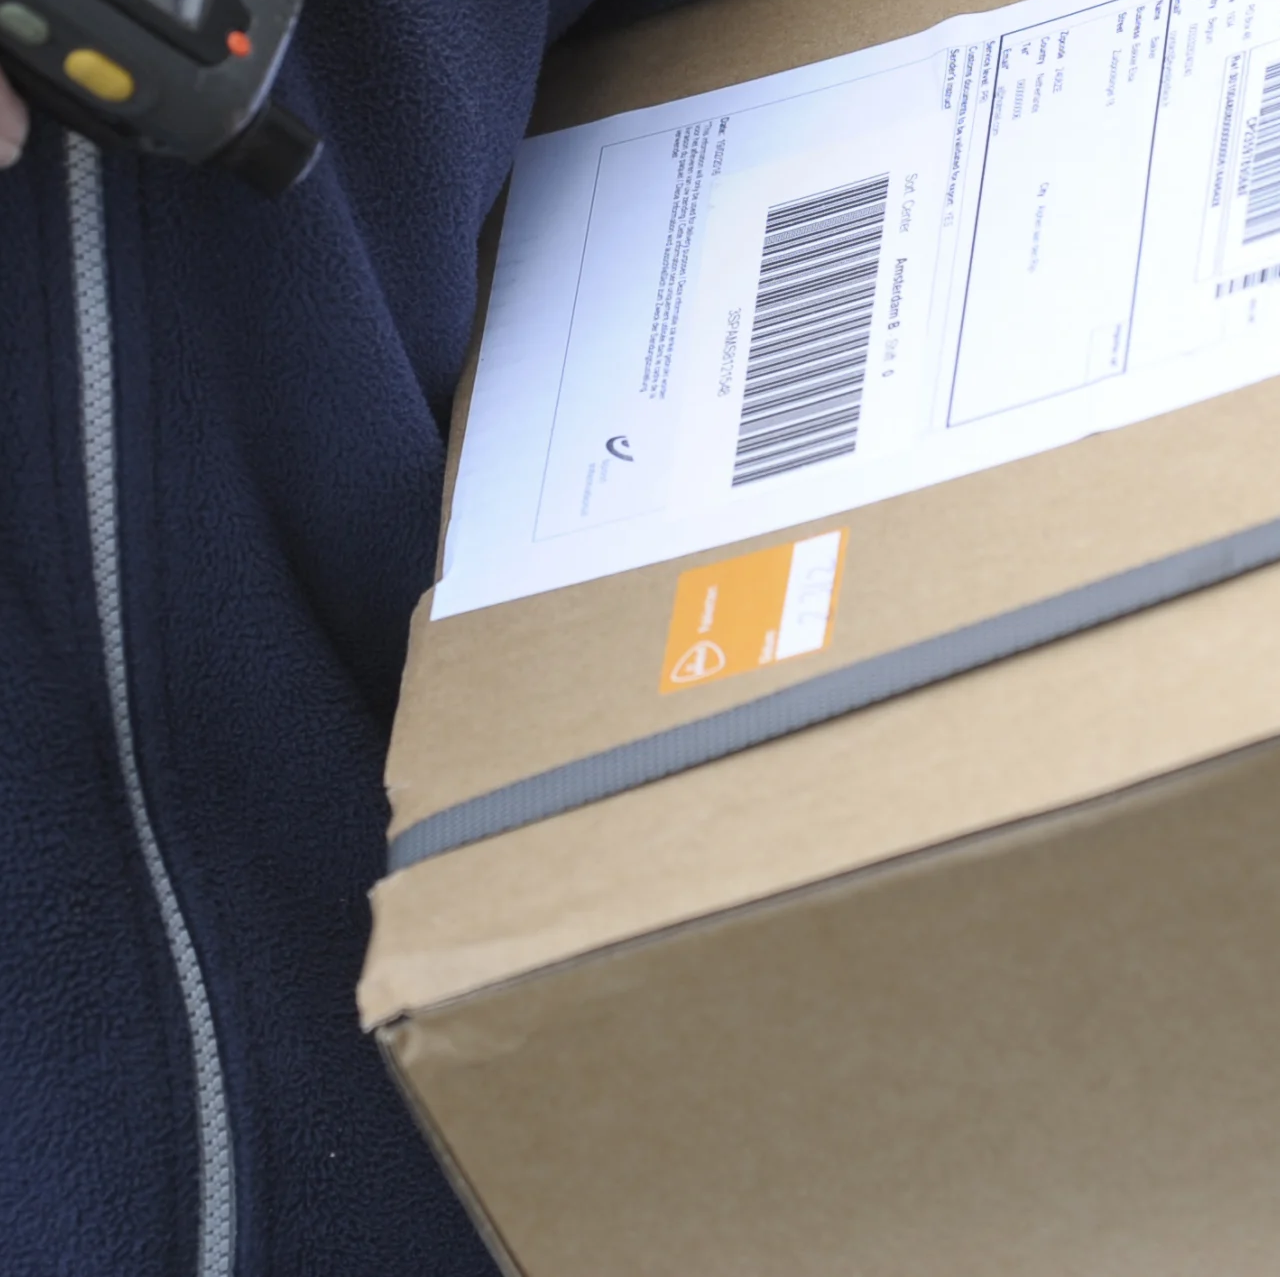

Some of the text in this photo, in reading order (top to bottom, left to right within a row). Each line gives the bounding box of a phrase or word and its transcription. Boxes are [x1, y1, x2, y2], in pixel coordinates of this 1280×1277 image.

[1115, 11, 1128, 34] Street
[1132, 5, 1146, 40] Business
[1153, 0, 1164, 21] Name
[983, 39, 996, 68] Service
[1035, 35, 1051, 65] Country
[1057, 30, 1070, 60] Zipcode
[945, 48, 961, 82] Sender's
[962, 45, 978, 79] Customs
[958, 78, 973, 117] documents
[697, 136, 709, 169] information
[951, 136, 963, 171] validated
[691, 179, 702, 193] only
[688, 201, 698, 217] used
[899, 199, 916, 233] Center
[889, 257, 909, 320] Amsterdam
[887, 320, 901, 331] B
